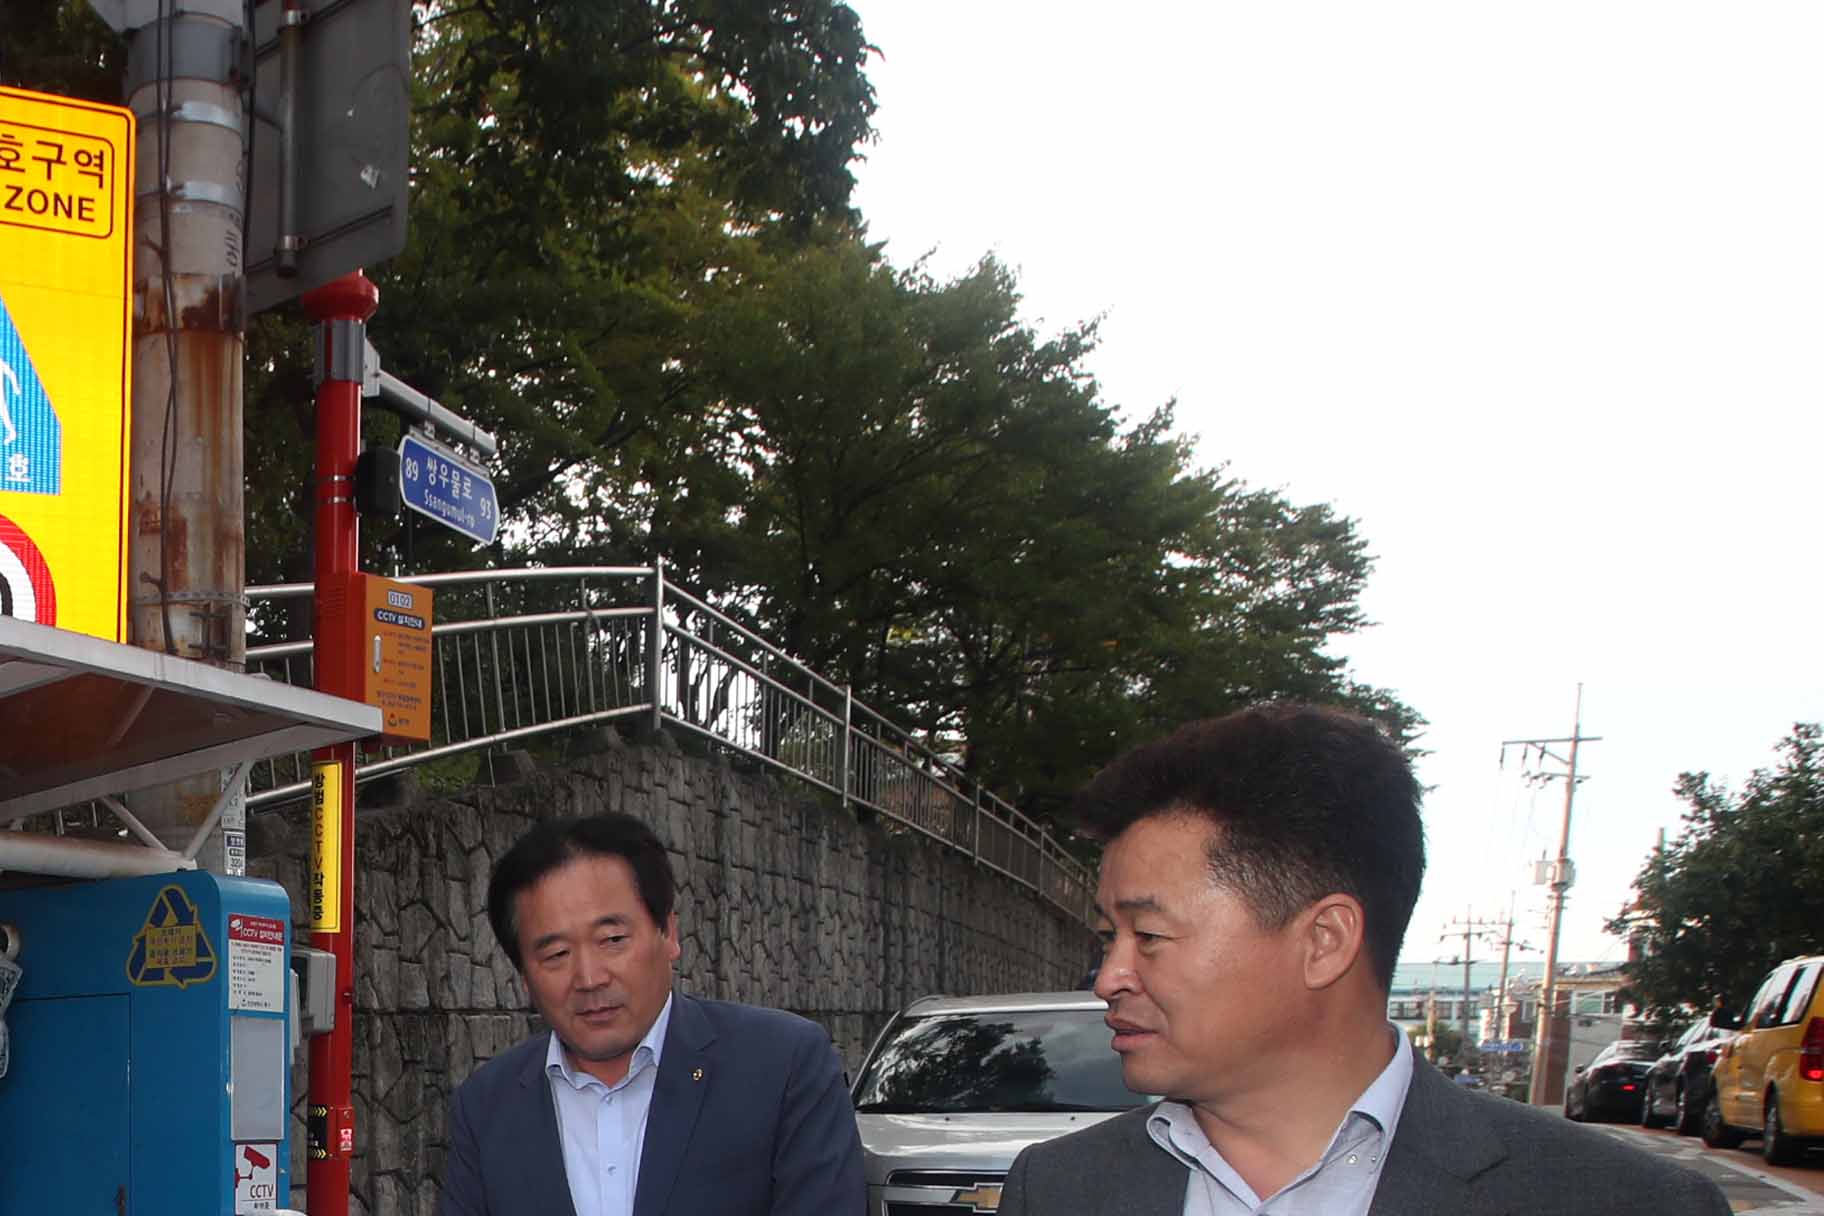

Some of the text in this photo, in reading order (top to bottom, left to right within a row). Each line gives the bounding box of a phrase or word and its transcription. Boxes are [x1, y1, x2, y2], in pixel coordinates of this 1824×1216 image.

[3, 184, 96, 223] ZONE
[427, 455, 473, 500] 쌍우물로
[250, 1184, 274, 1199] CCTV
